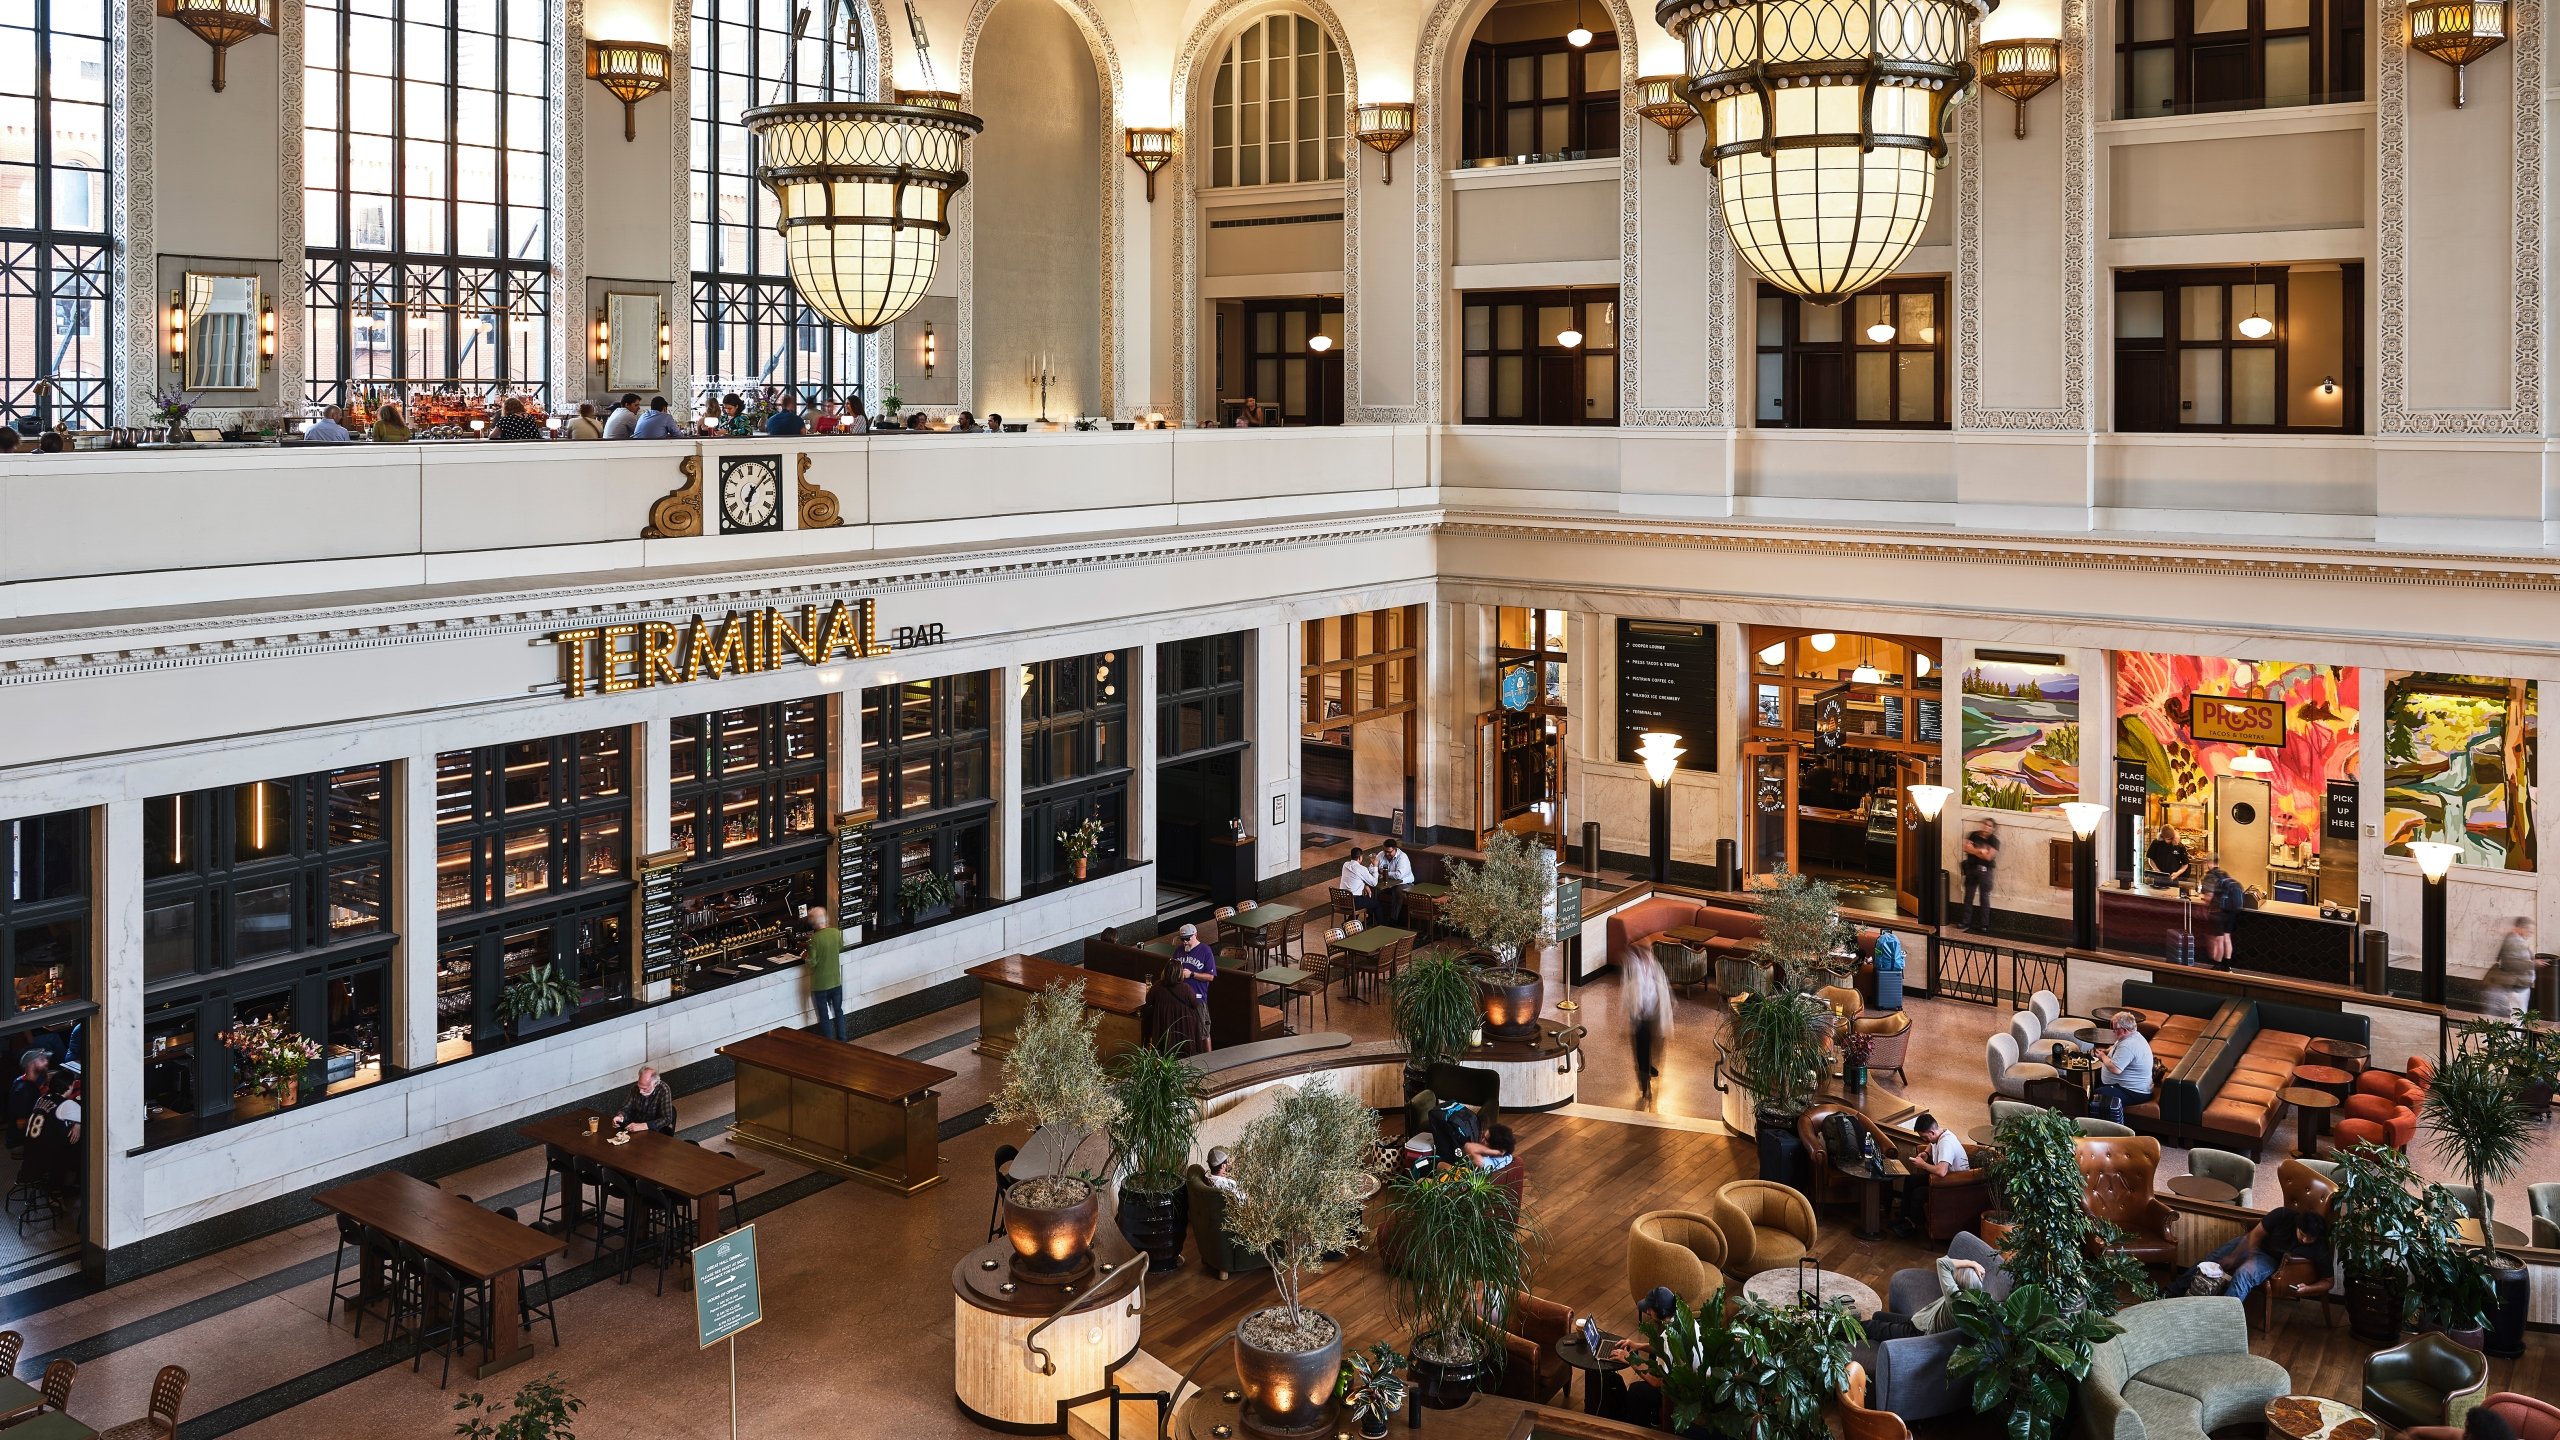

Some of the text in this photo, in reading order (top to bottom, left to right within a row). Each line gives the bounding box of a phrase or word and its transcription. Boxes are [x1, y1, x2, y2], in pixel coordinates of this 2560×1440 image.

[550, 598, 944, 698] TERMINAL BAR
[2203, 702, 2272, 731] PRESS
[2120, 772, 2144, 781] PLACE
[2118, 784, 2145, 793] ORDER
[2121, 796, 2142, 805] HERE
[2333, 794, 2353, 803] PICK
[2337, 807, 2350, 815] UP
[2331, 819, 2355, 828] HERE
[25, 1113, 45, 1139] 18
